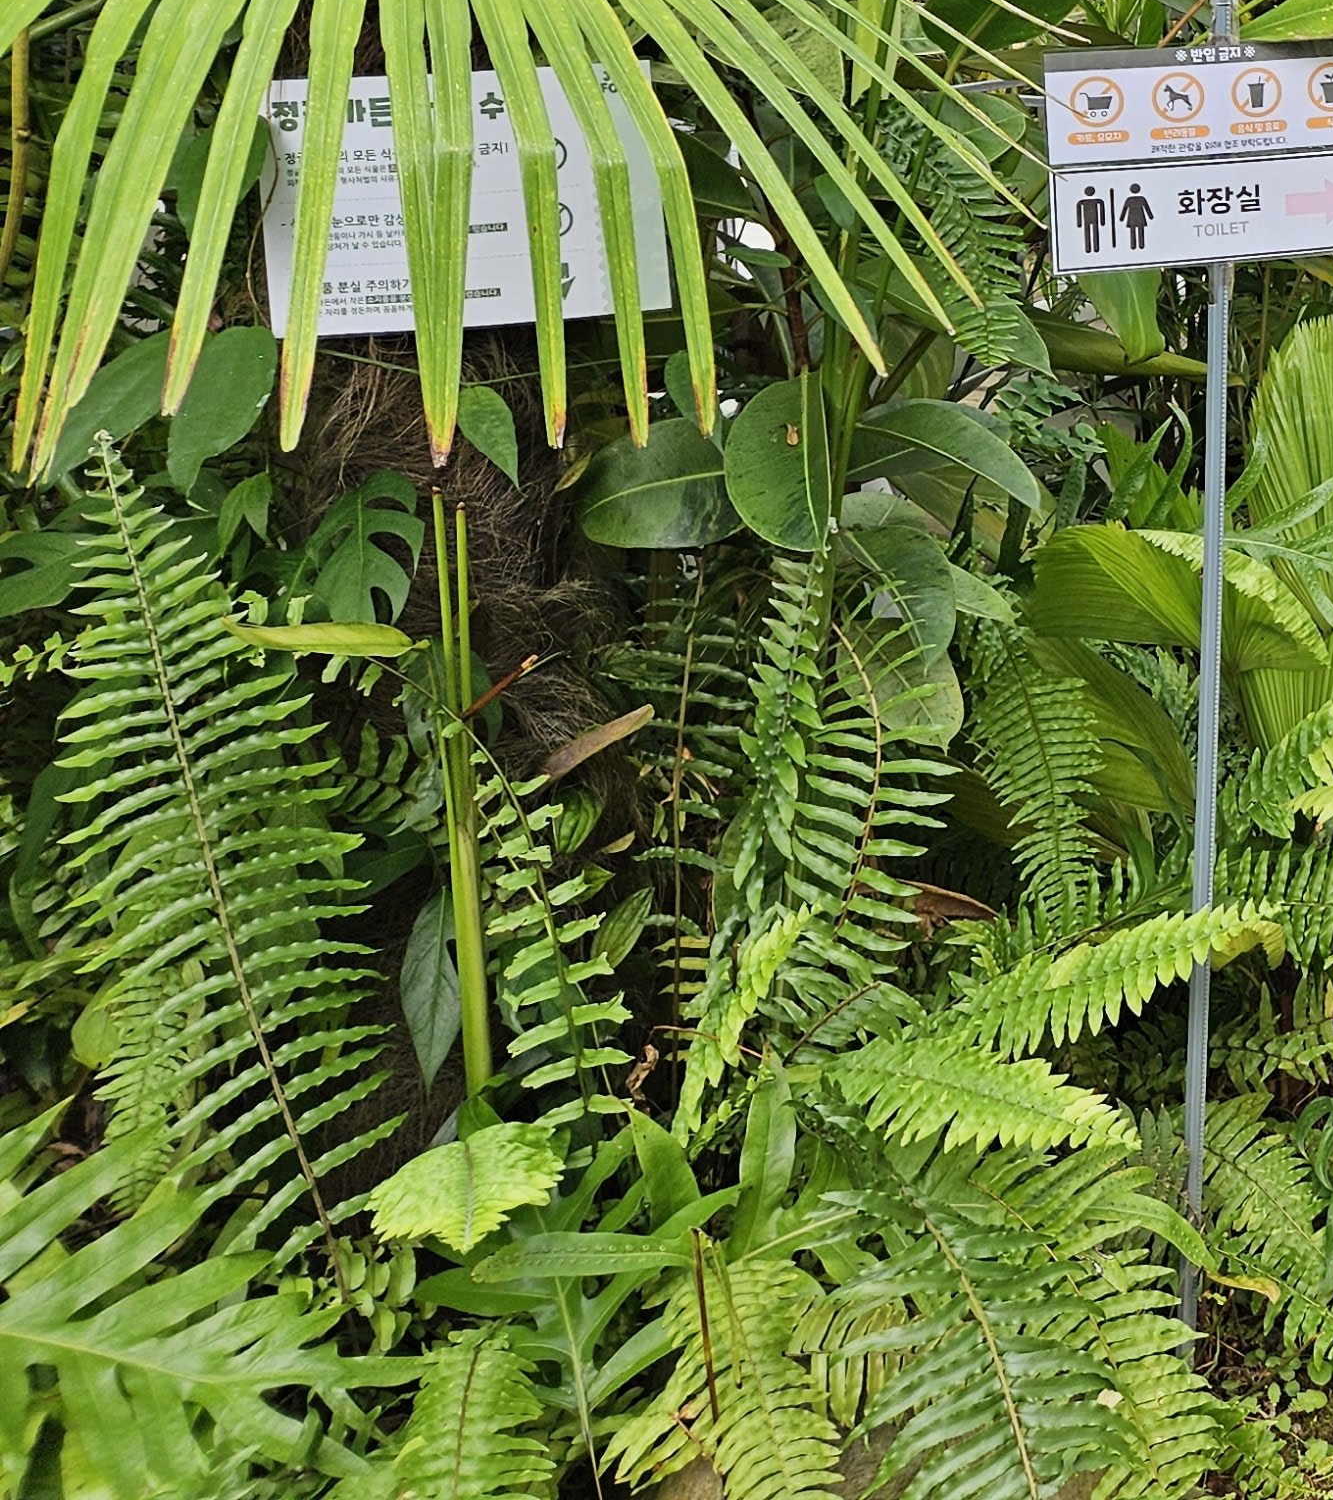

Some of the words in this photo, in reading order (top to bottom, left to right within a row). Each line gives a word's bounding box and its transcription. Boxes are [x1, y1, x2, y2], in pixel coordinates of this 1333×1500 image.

[1190, 47, 1215, 63] 반입
[1218, 46, 1241, 61] 금지
[1097, 131, 1121, 142] 유모차
[353, 149, 377, 162] 모든
[478, 142, 509, 155] 금지!
[1178, 142, 1201, 152] 관람을
[1205, 140, 1221, 150] 위해
[1178, 184, 1262, 216] 화장실
[332, 214, 379, 229] 눈으로만
[1194, 221, 1250, 238] TOILET
[338, 280, 361, 294] 분실
